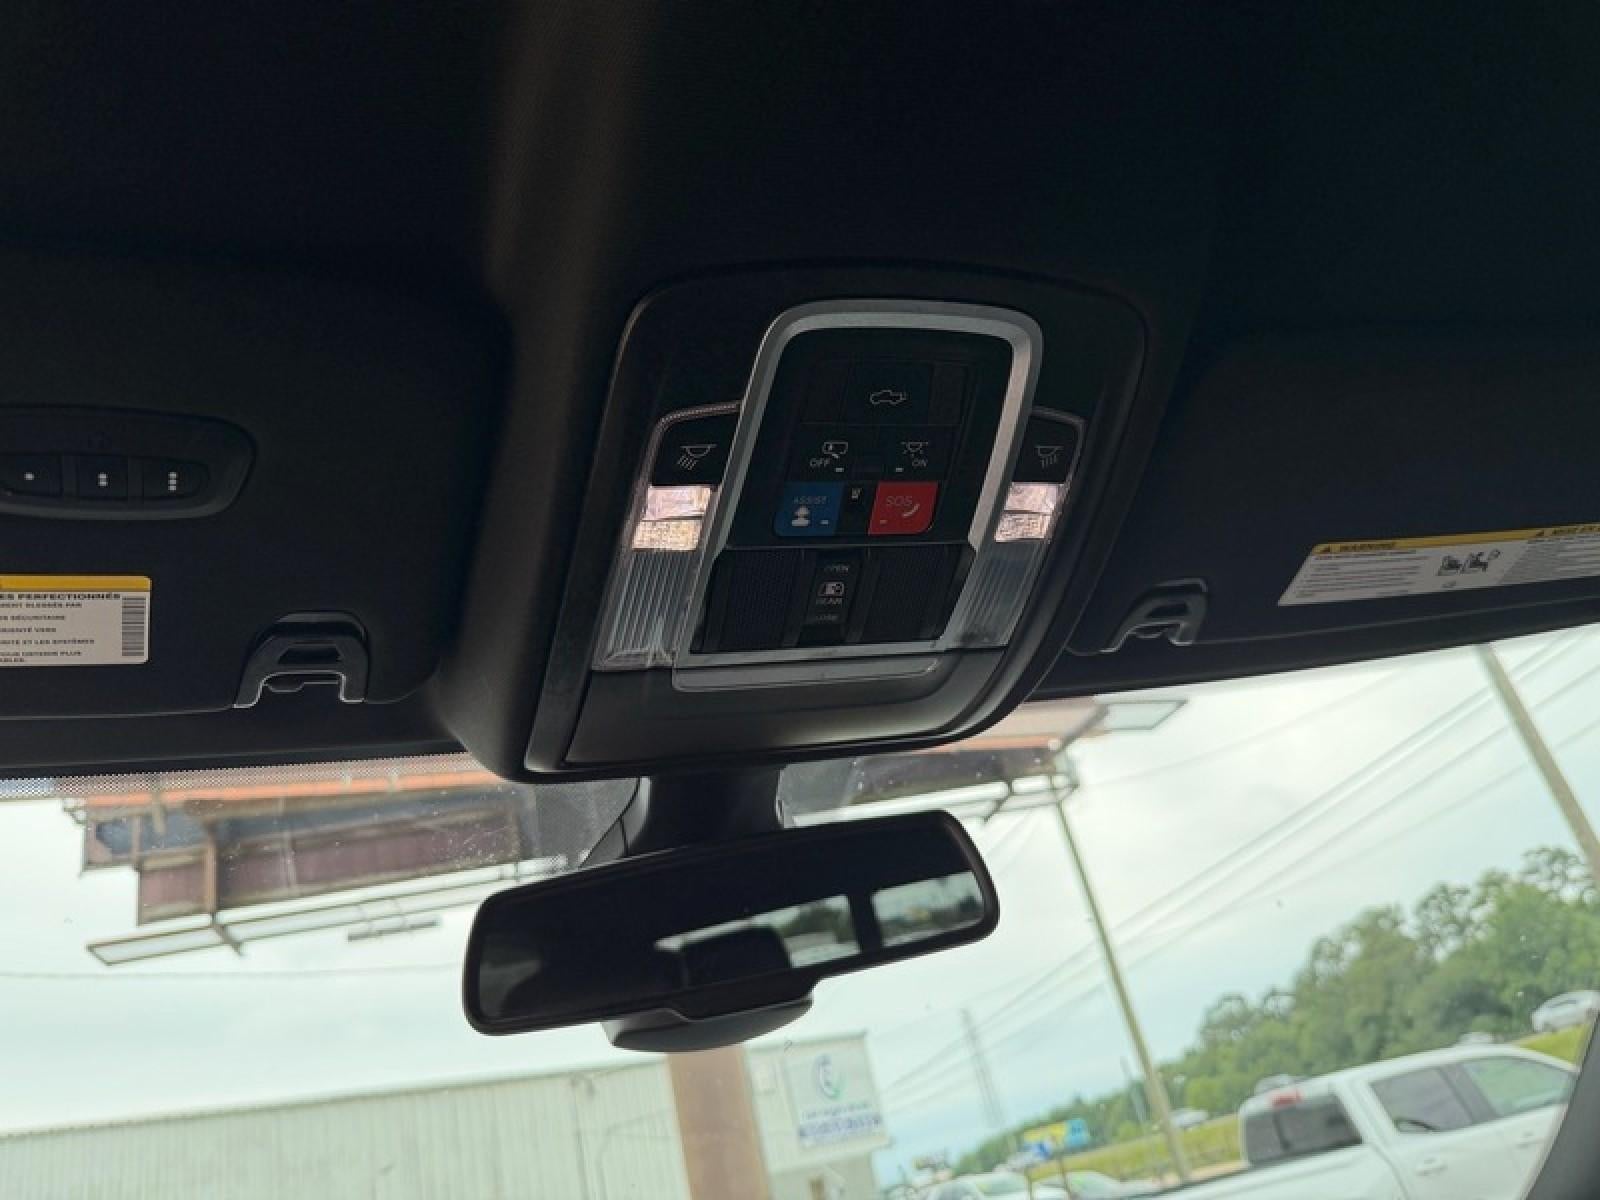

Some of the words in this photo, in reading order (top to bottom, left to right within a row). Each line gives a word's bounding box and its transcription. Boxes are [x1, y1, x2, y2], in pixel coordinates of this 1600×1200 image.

[809, 457, 831, 468] OFF
[912, 458, 928, 468] ON
[886, 496, 913, 506] SOS
